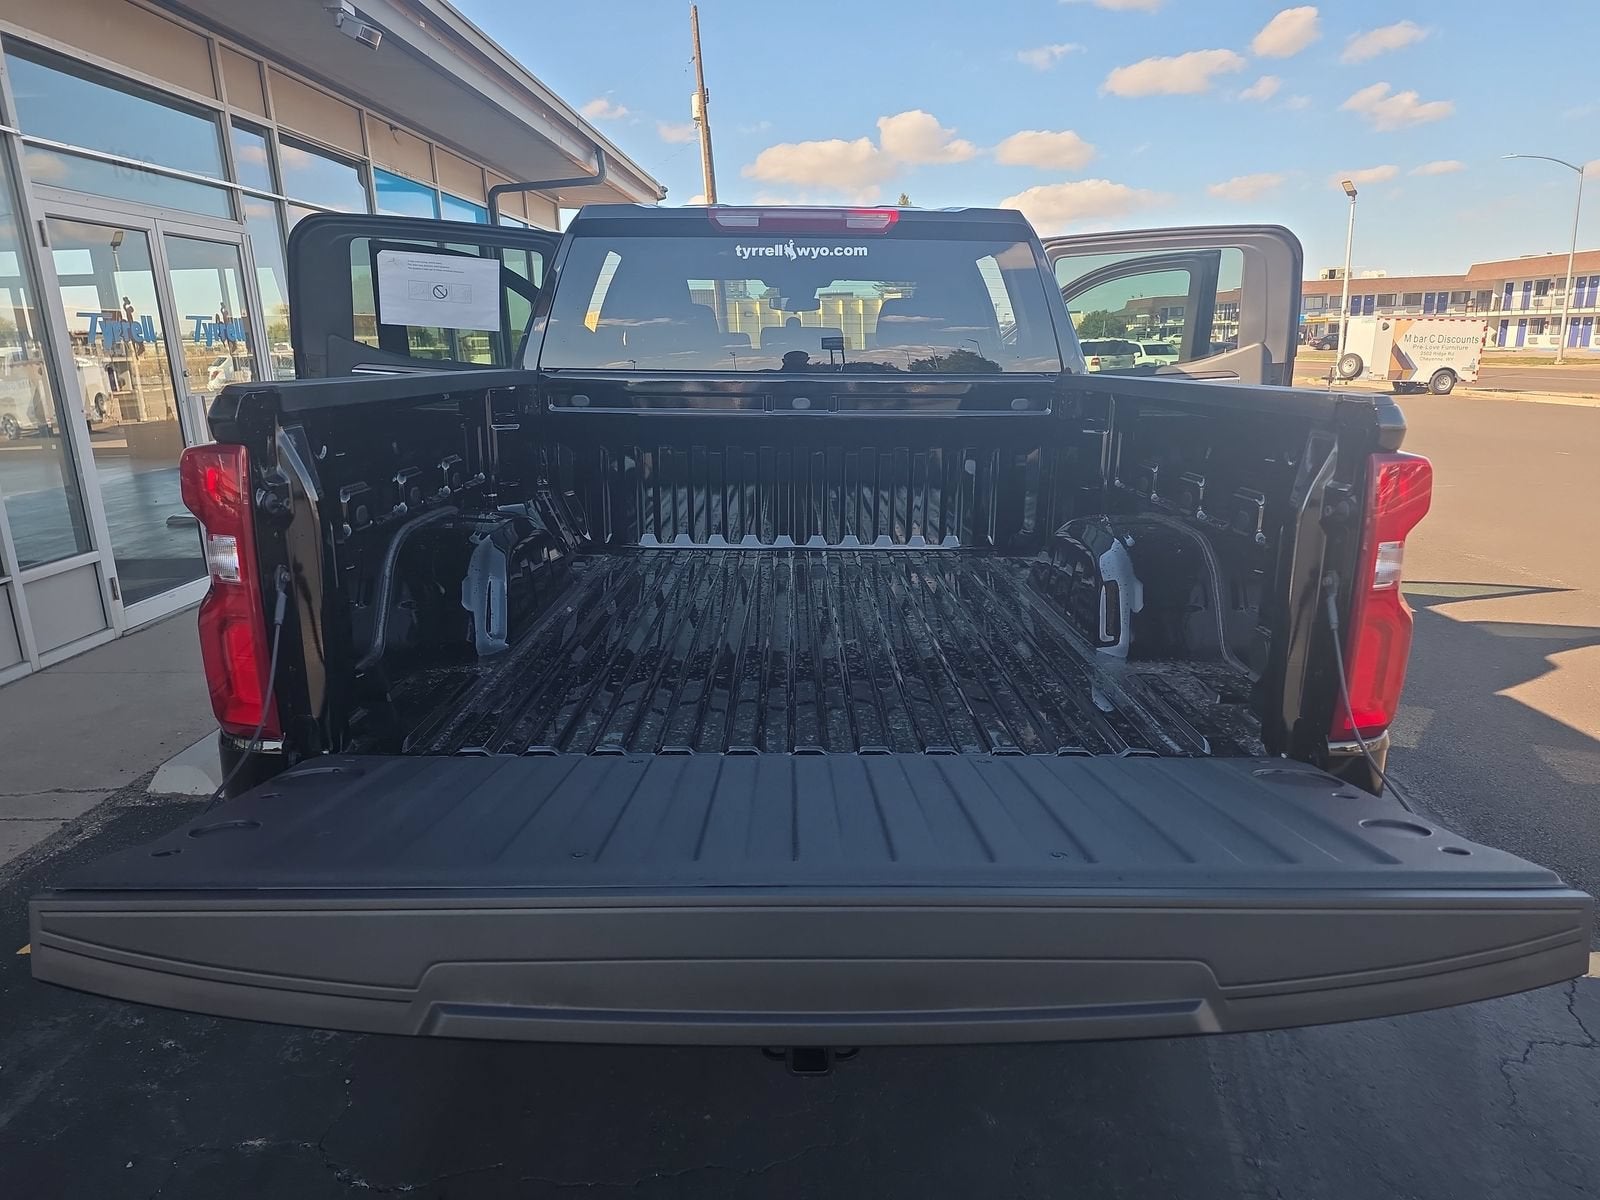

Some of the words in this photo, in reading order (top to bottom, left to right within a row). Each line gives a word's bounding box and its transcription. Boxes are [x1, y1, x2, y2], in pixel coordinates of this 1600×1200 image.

[735, 244, 783, 259] tyrrell
[796, 246, 868, 259] wyo.com
[76, 312, 158, 350] Tyrrell
[185, 315, 248, 349] Tyrrell
[1404, 334, 1412, 343] M
[1413, 334, 1427, 343] bar
[1429, 334, 1436, 344] C
[1437, 334, 1480, 344] Discounts
